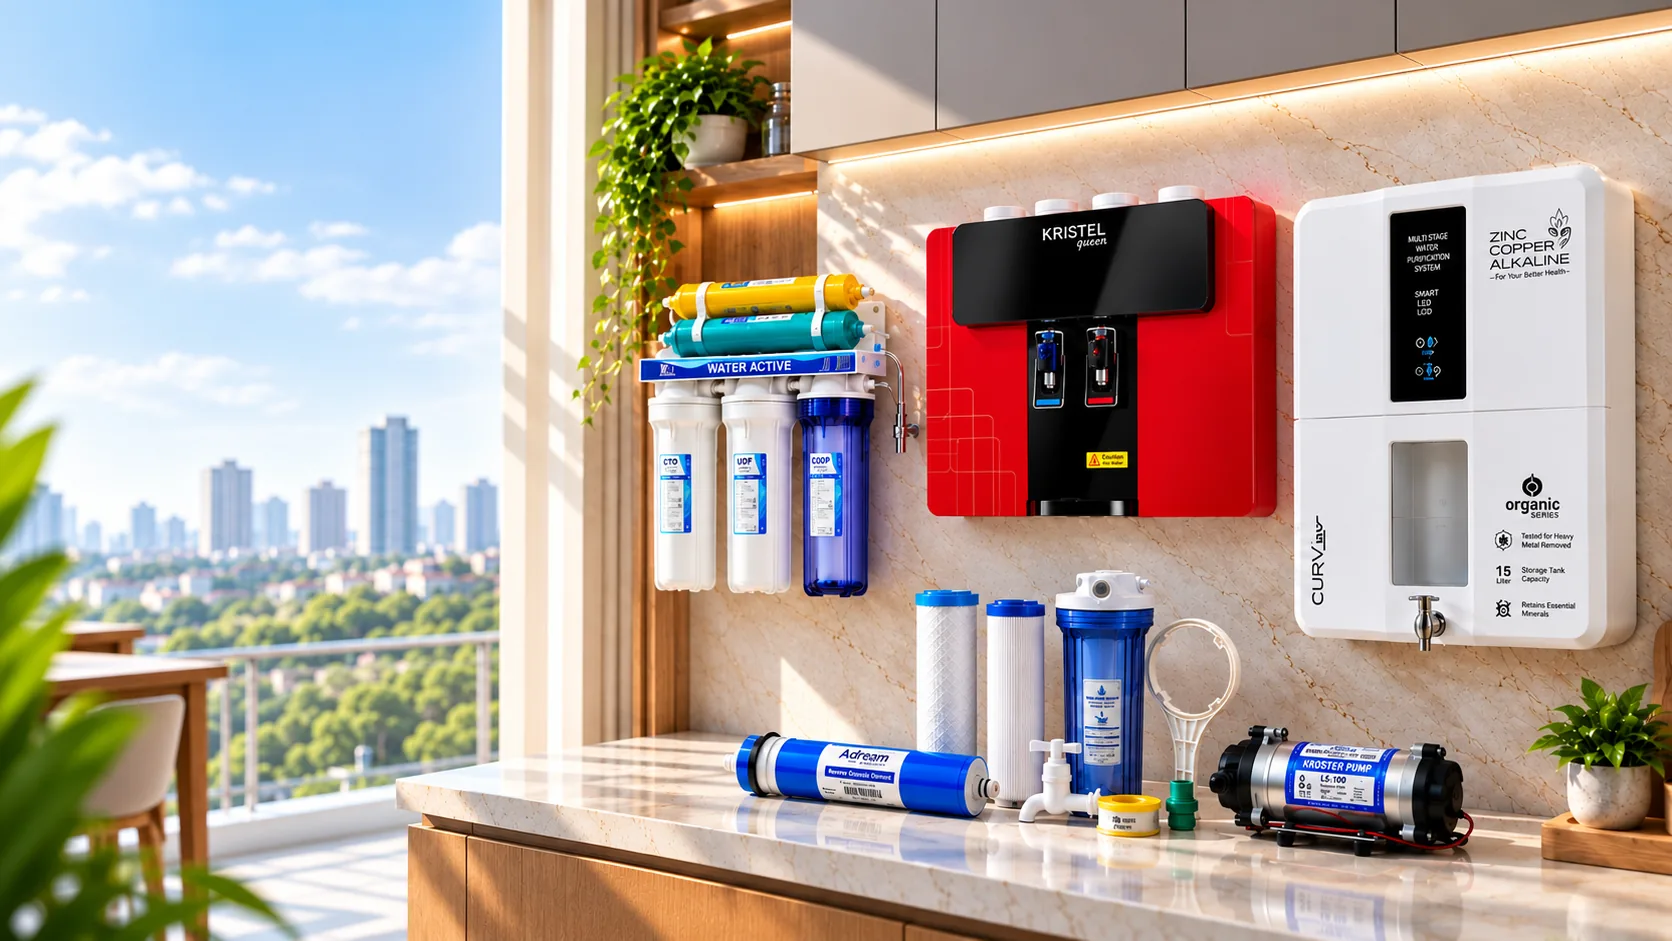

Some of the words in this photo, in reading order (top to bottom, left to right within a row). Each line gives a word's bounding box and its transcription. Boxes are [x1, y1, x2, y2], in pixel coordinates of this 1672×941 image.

[1042, 223, 1106, 241] KRISTEL
[1428, 232, 1449, 242] STAGE
[1489, 229, 1527, 243] ZINC
[1076, 238, 1107, 251] queen
[1489, 240, 1555, 256] COPPER
[1489, 253, 1570, 270] ALKALINE
[1414, 289, 1439, 298] SMART
[707, 361, 746, 374] WATER
[749, 360, 792, 373] ACTIVE
[663, 458, 679, 466] CTO
[737, 457, 753, 466] UDF
[1505, 497, 1560, 514] organic
[1530, 511, 1559, 519] SERIES
[1521, 532, 1542, 540] Tested
[1543, 532, 1553, 540] for
[1553, 532, 1574, 541] Heavy
[1521, 541, 1540, 549] Metal
[1541, 541, 1571, 549] Removed
[1495, 565, 1511, 577] 15
[1521, 566, 1548, 575] Storage
[1549, 566, 1566, 574] Tank
[1521, 575, 1550, 584] Capacity
[1521, 601, 1545, 609] Retains
[1546, 602, 1576, 610] Essential
[1302, 759, 1344, 772] KROSTER
[1345, 762, 1372, 773] PUMP
